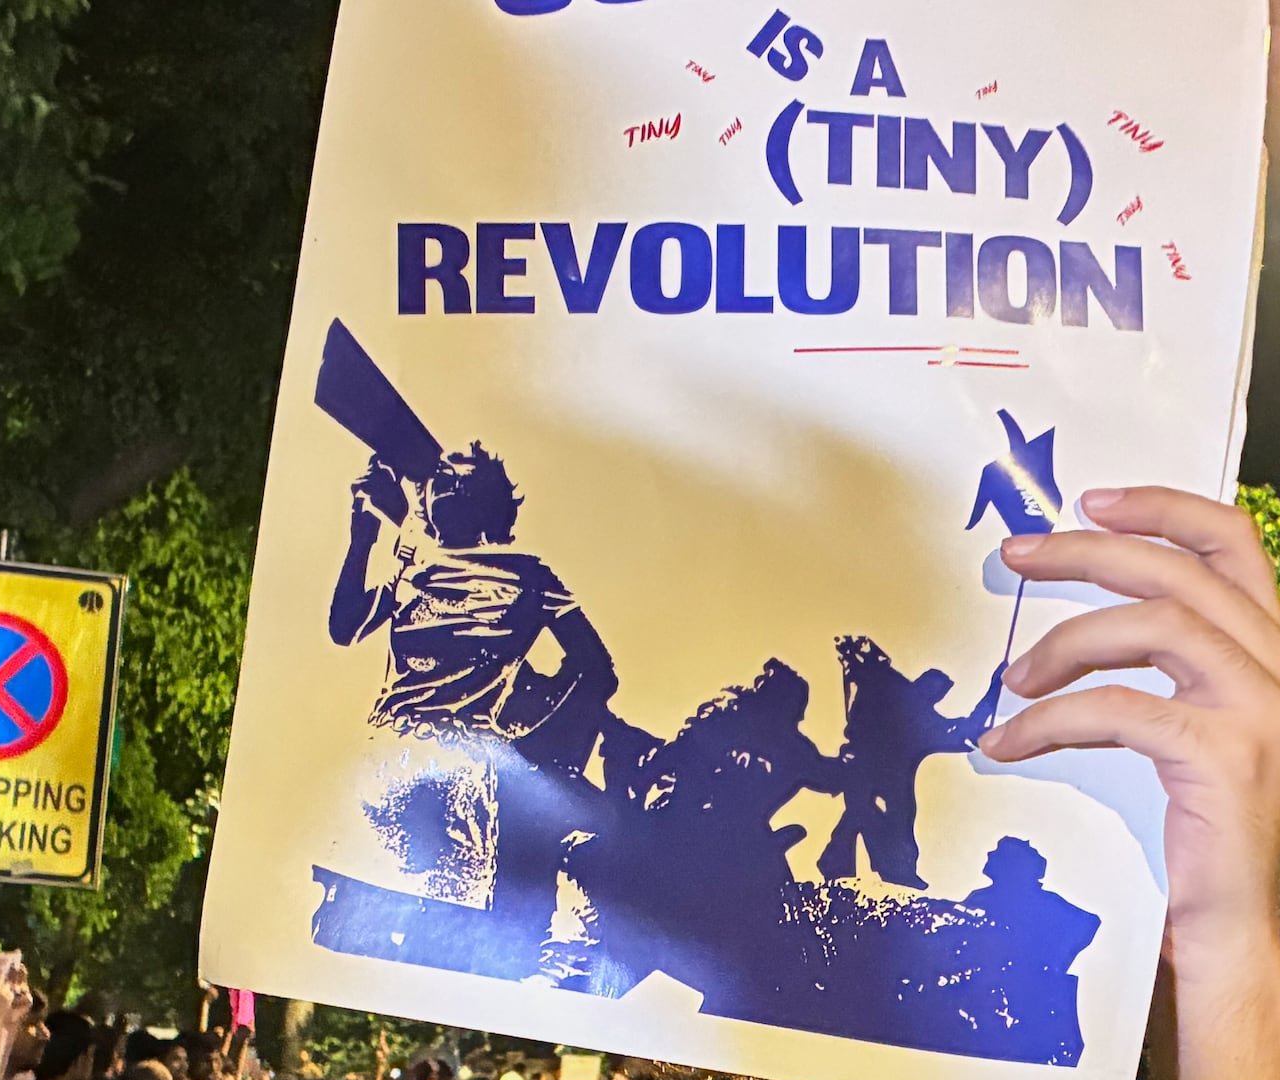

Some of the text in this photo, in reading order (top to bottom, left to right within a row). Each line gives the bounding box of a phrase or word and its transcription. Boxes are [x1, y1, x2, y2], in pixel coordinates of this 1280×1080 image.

[746, 8, 907, 98] IS A
[766, 98, 1093, 227] (TINY)
[398, 221, 1144, 332] REVOLUTION
